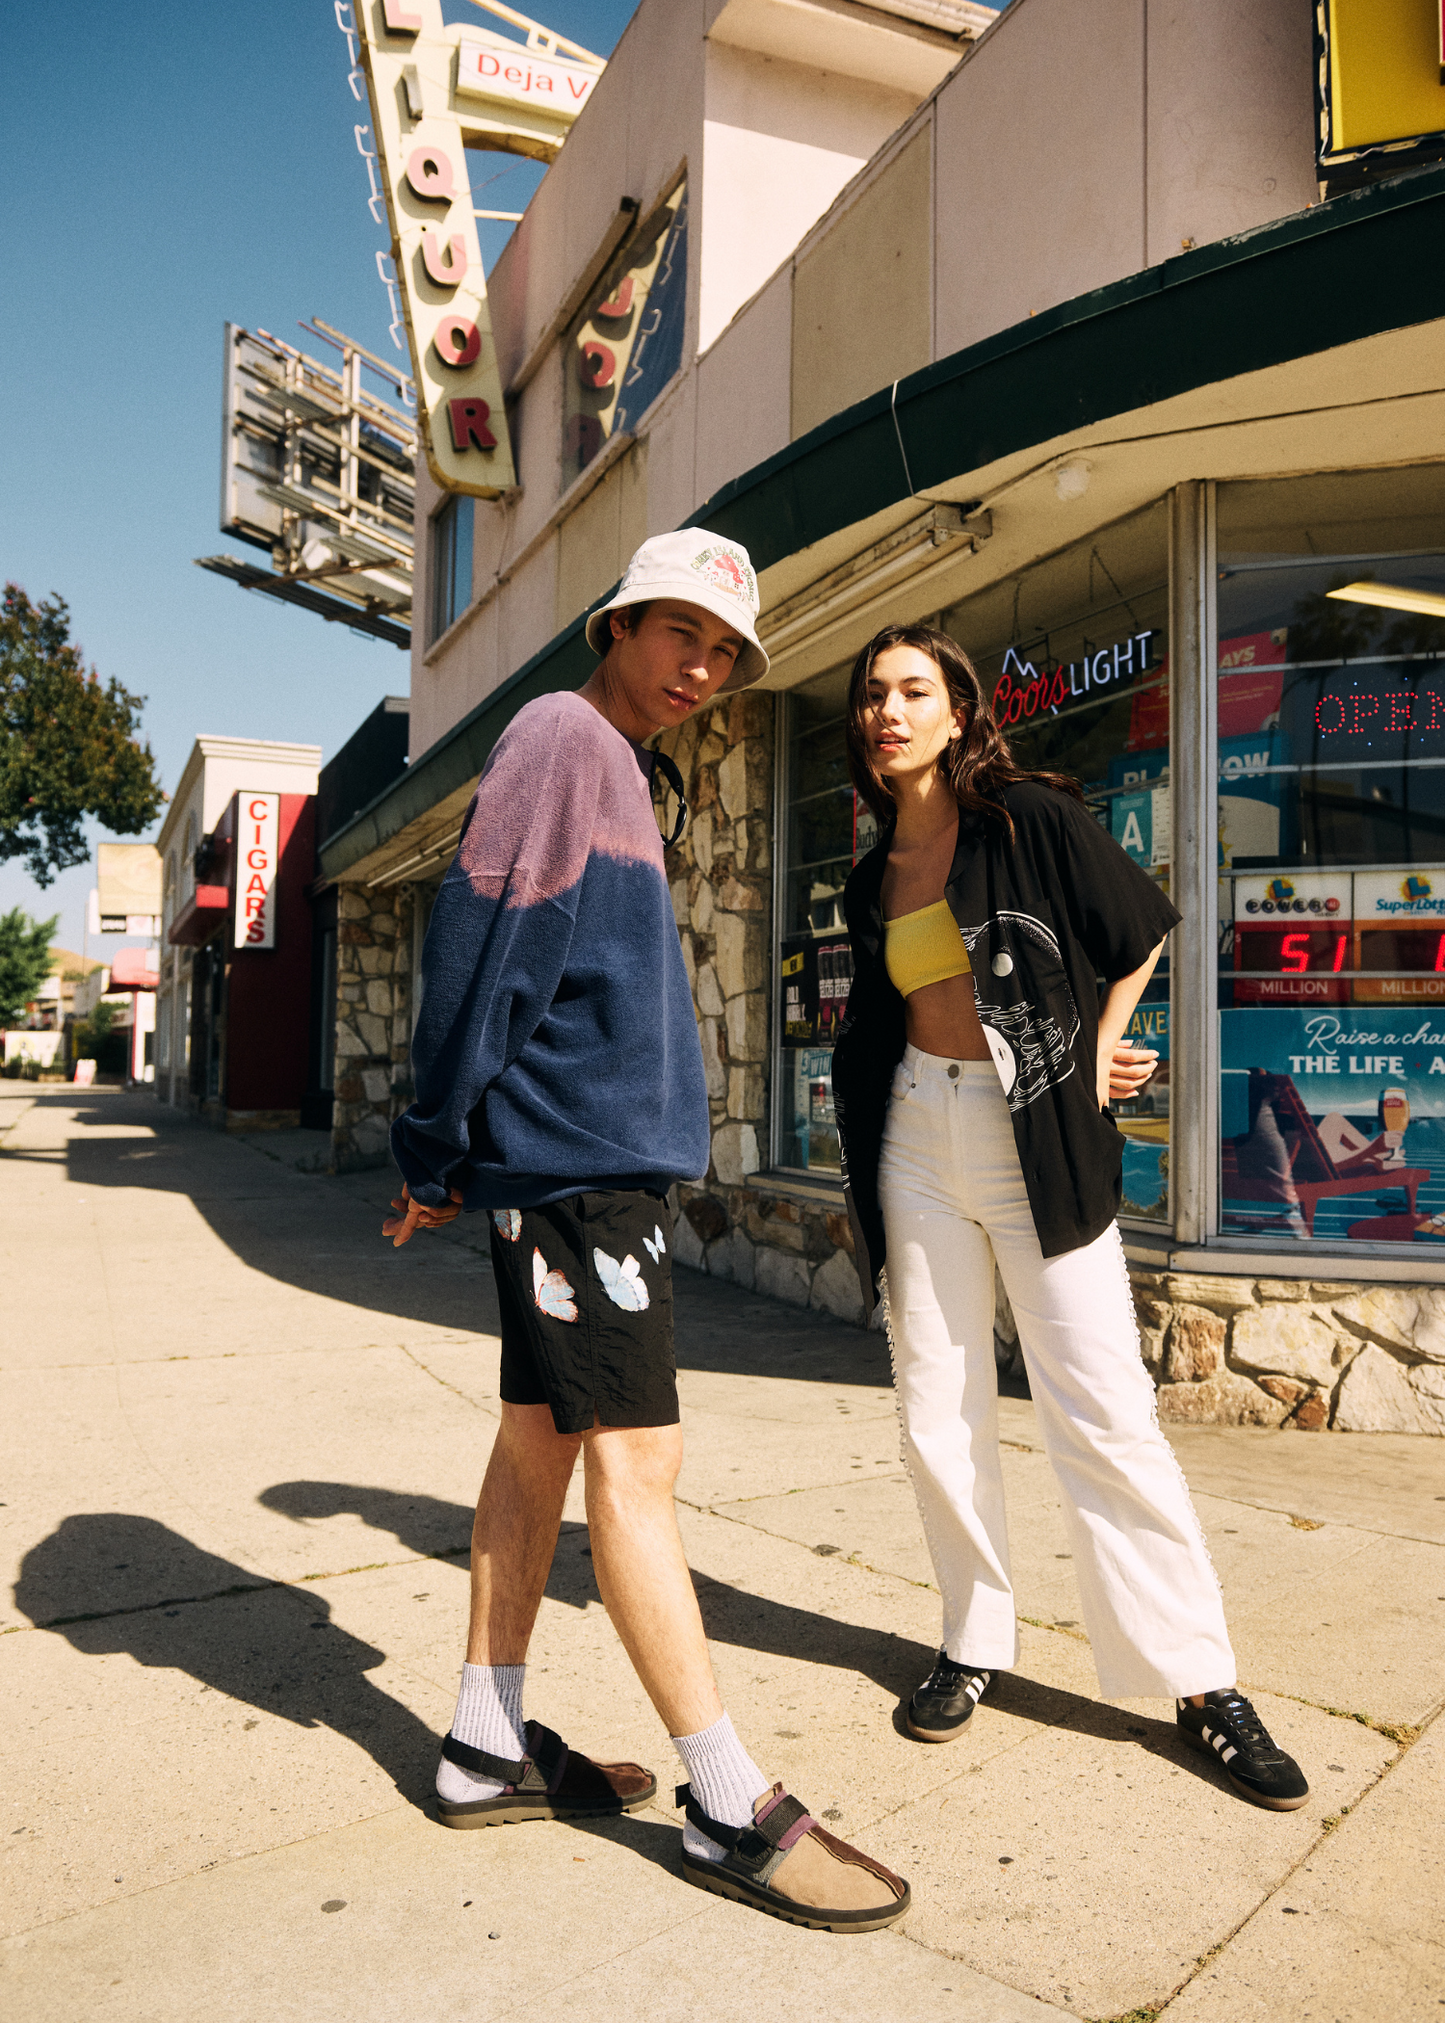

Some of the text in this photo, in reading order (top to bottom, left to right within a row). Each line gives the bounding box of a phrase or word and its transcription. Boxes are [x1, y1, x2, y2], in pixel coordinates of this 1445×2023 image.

[477, 53, 588, 99] Deja V
[384, 0, 497, 450] LIQUOR
[1221, 645, 1256, 668] AYS
[991, 630, 1153, 729] Coors LIGHT
[1219, 751, 1271, 782] OW
[1121, 811, 1145, 852] A
[246, 799, 268, 944] CIGARS
[1281, 933, 1347, 973] 51
[1261, 981, 1328, 995] MILLION
[1381, 981, 1445, 995] MILLIO
[1124, 1010, 1169, 1036] AVE
[1304, 1015, 1445, 1055] Raise a cha
[811, 1055, 832, 1077] WIN
[1288, 1055, 1445, 1075] THE LIFE A
